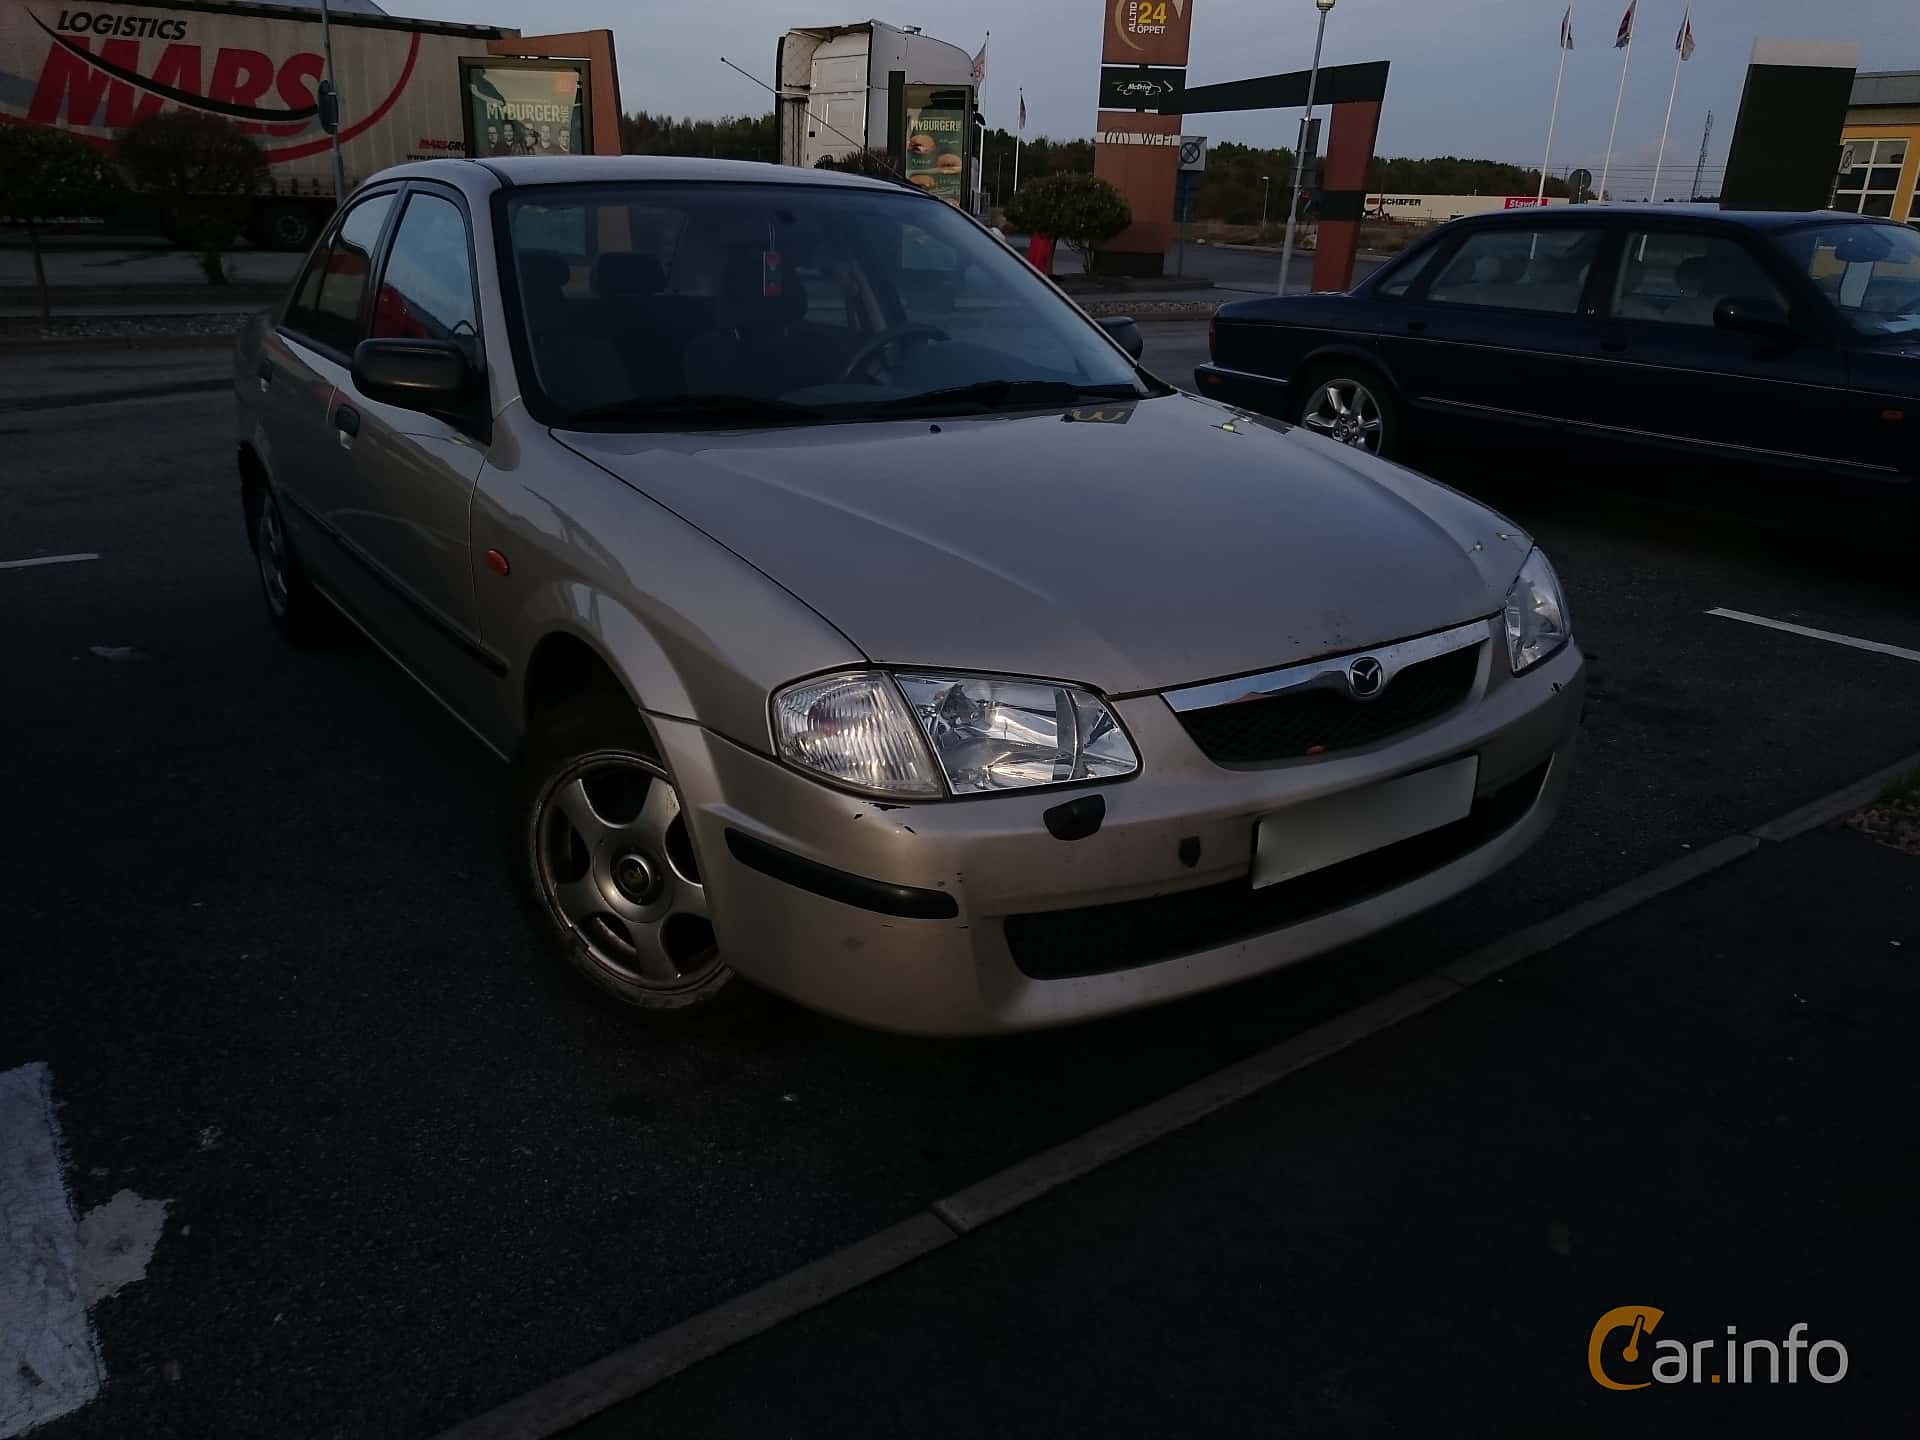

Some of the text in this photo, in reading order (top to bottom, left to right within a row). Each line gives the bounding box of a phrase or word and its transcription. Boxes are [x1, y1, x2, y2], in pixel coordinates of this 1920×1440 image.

[57, 11, 187, 39] LOGISTICS
[1128, 1, 1138, 32] ALLTID
[1137, 2, 1167, 25] 24
[1137, 24, 1166, 34] ÖPPET
[27, 35, 325, 137] MARS
[1142, 131, 1173, 146] Wi-Fi
